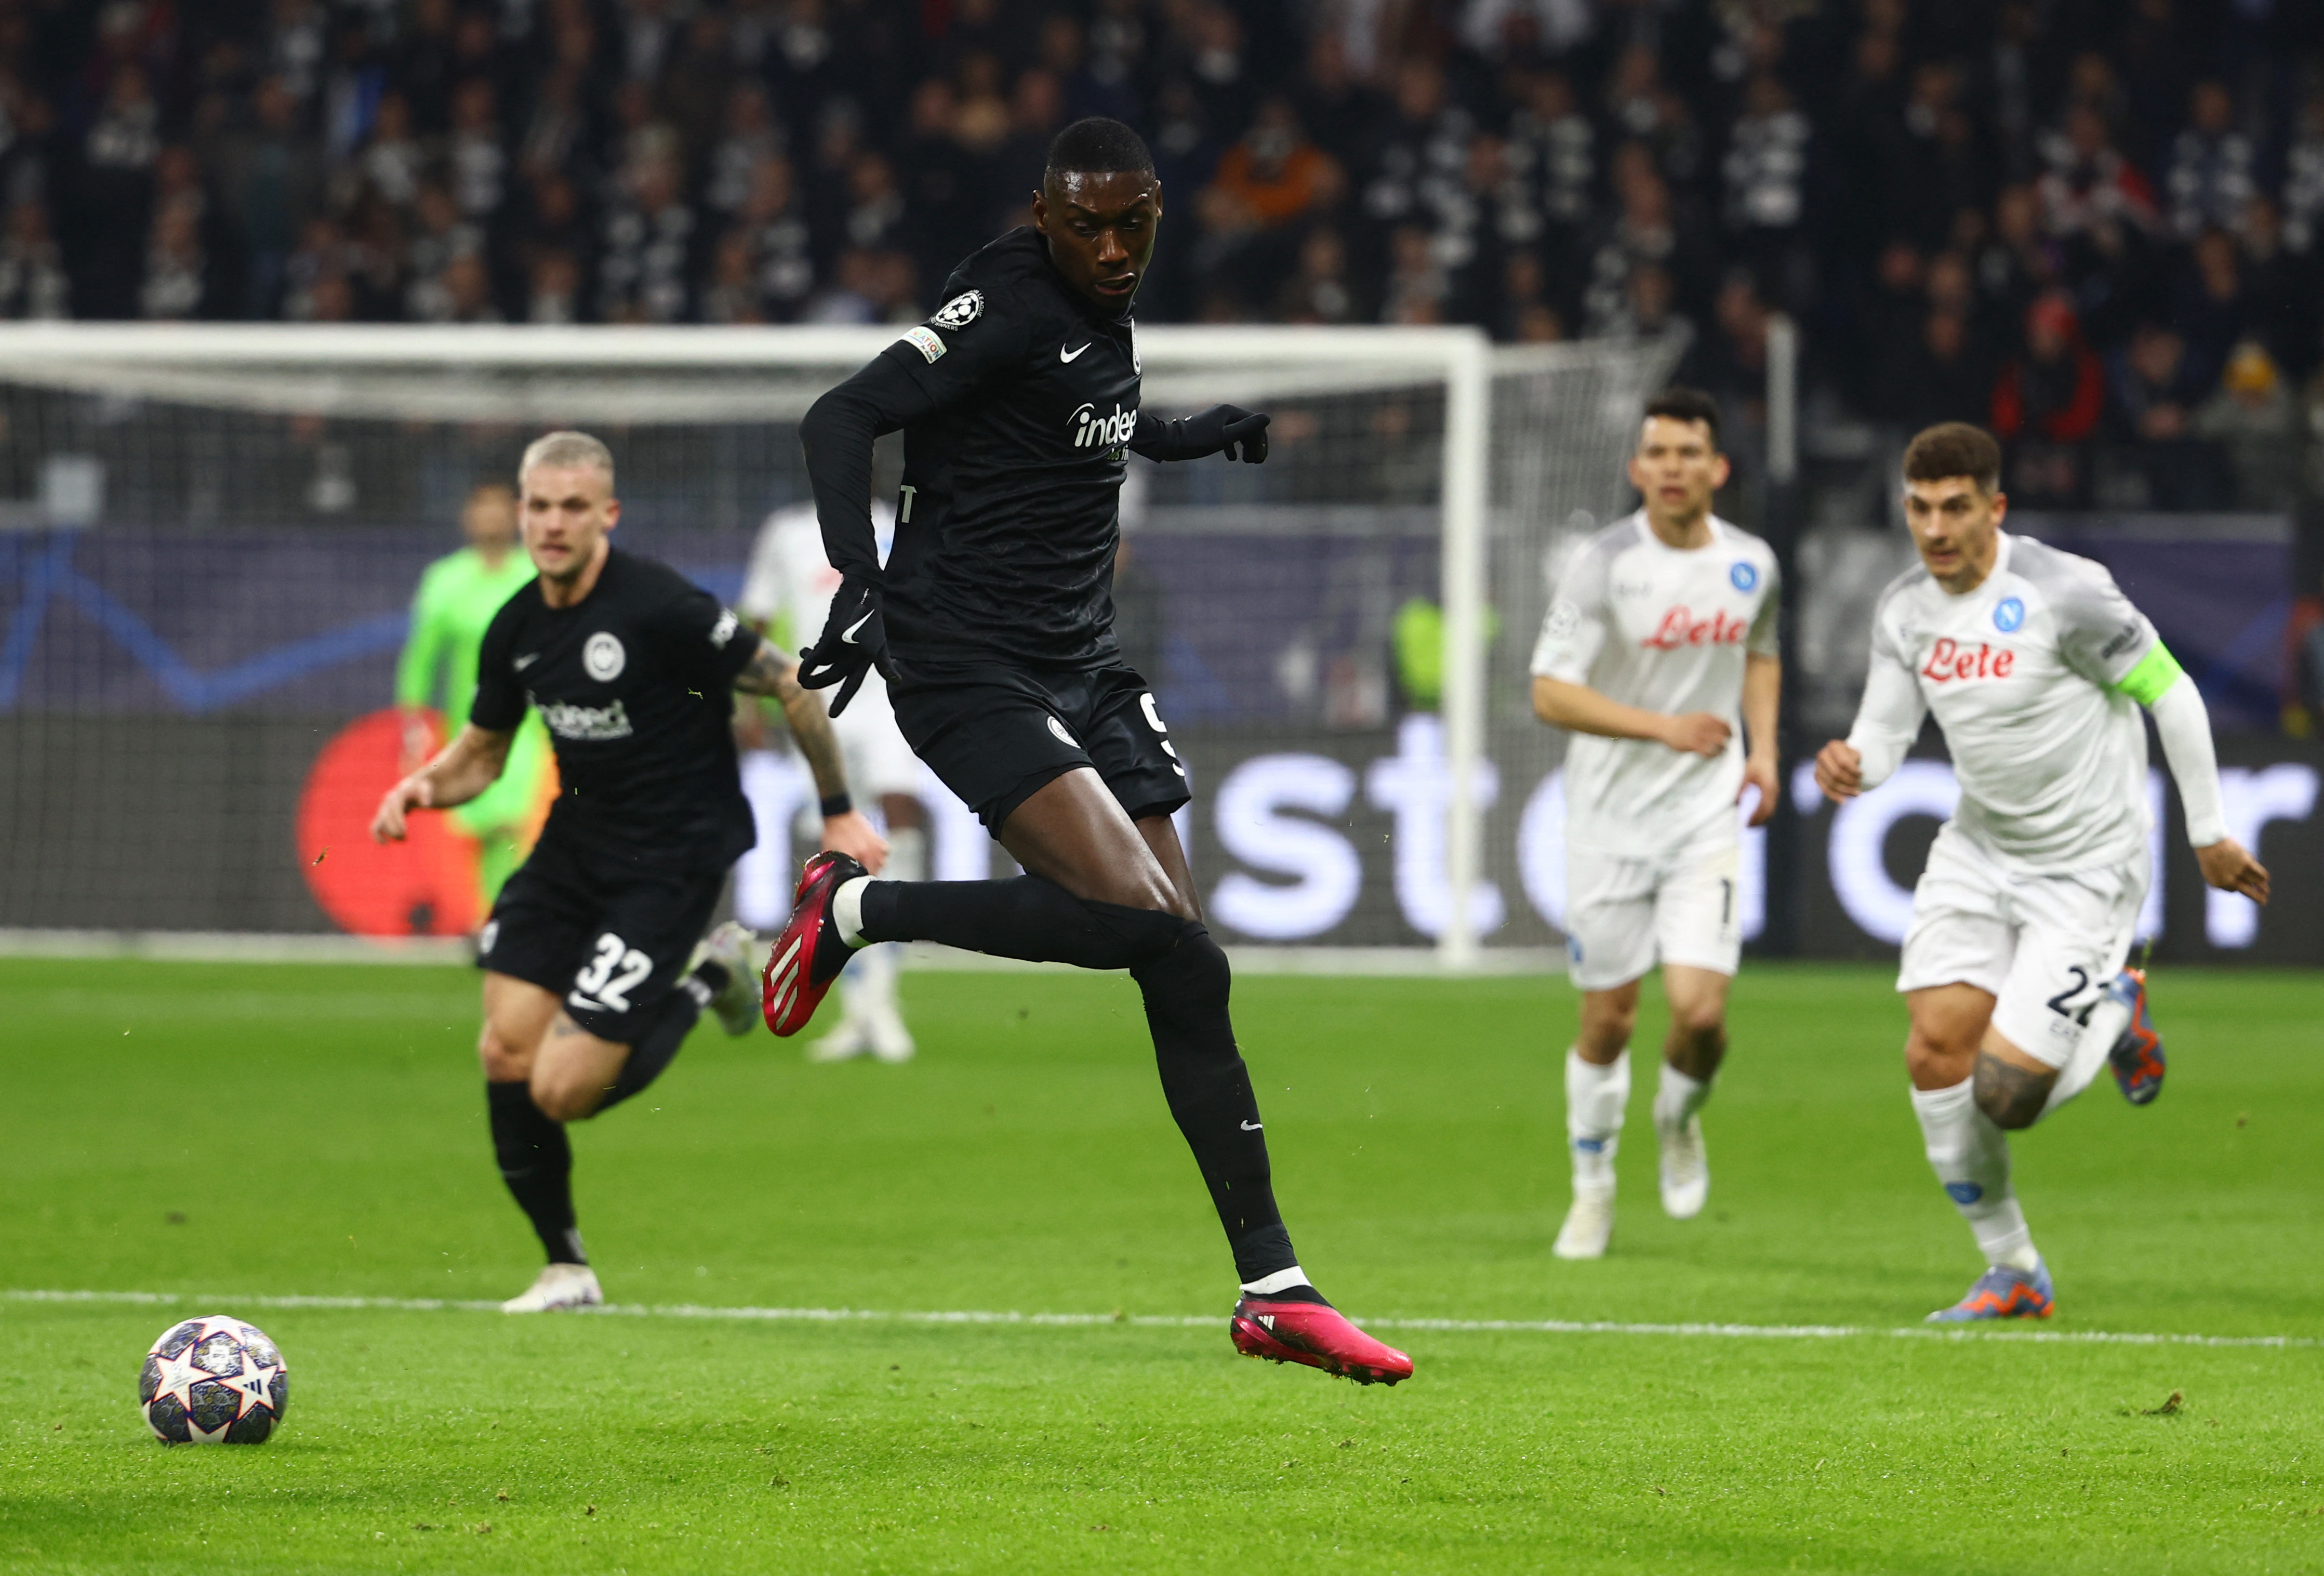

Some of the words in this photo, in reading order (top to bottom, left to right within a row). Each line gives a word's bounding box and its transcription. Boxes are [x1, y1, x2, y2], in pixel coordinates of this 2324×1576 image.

[1067, 403, 1137, 447] indee
[1639, 604, 1749, 650] Lete
[1923, 638, 2014, 682] Lete
[576, 932, 654, 1013] 32
